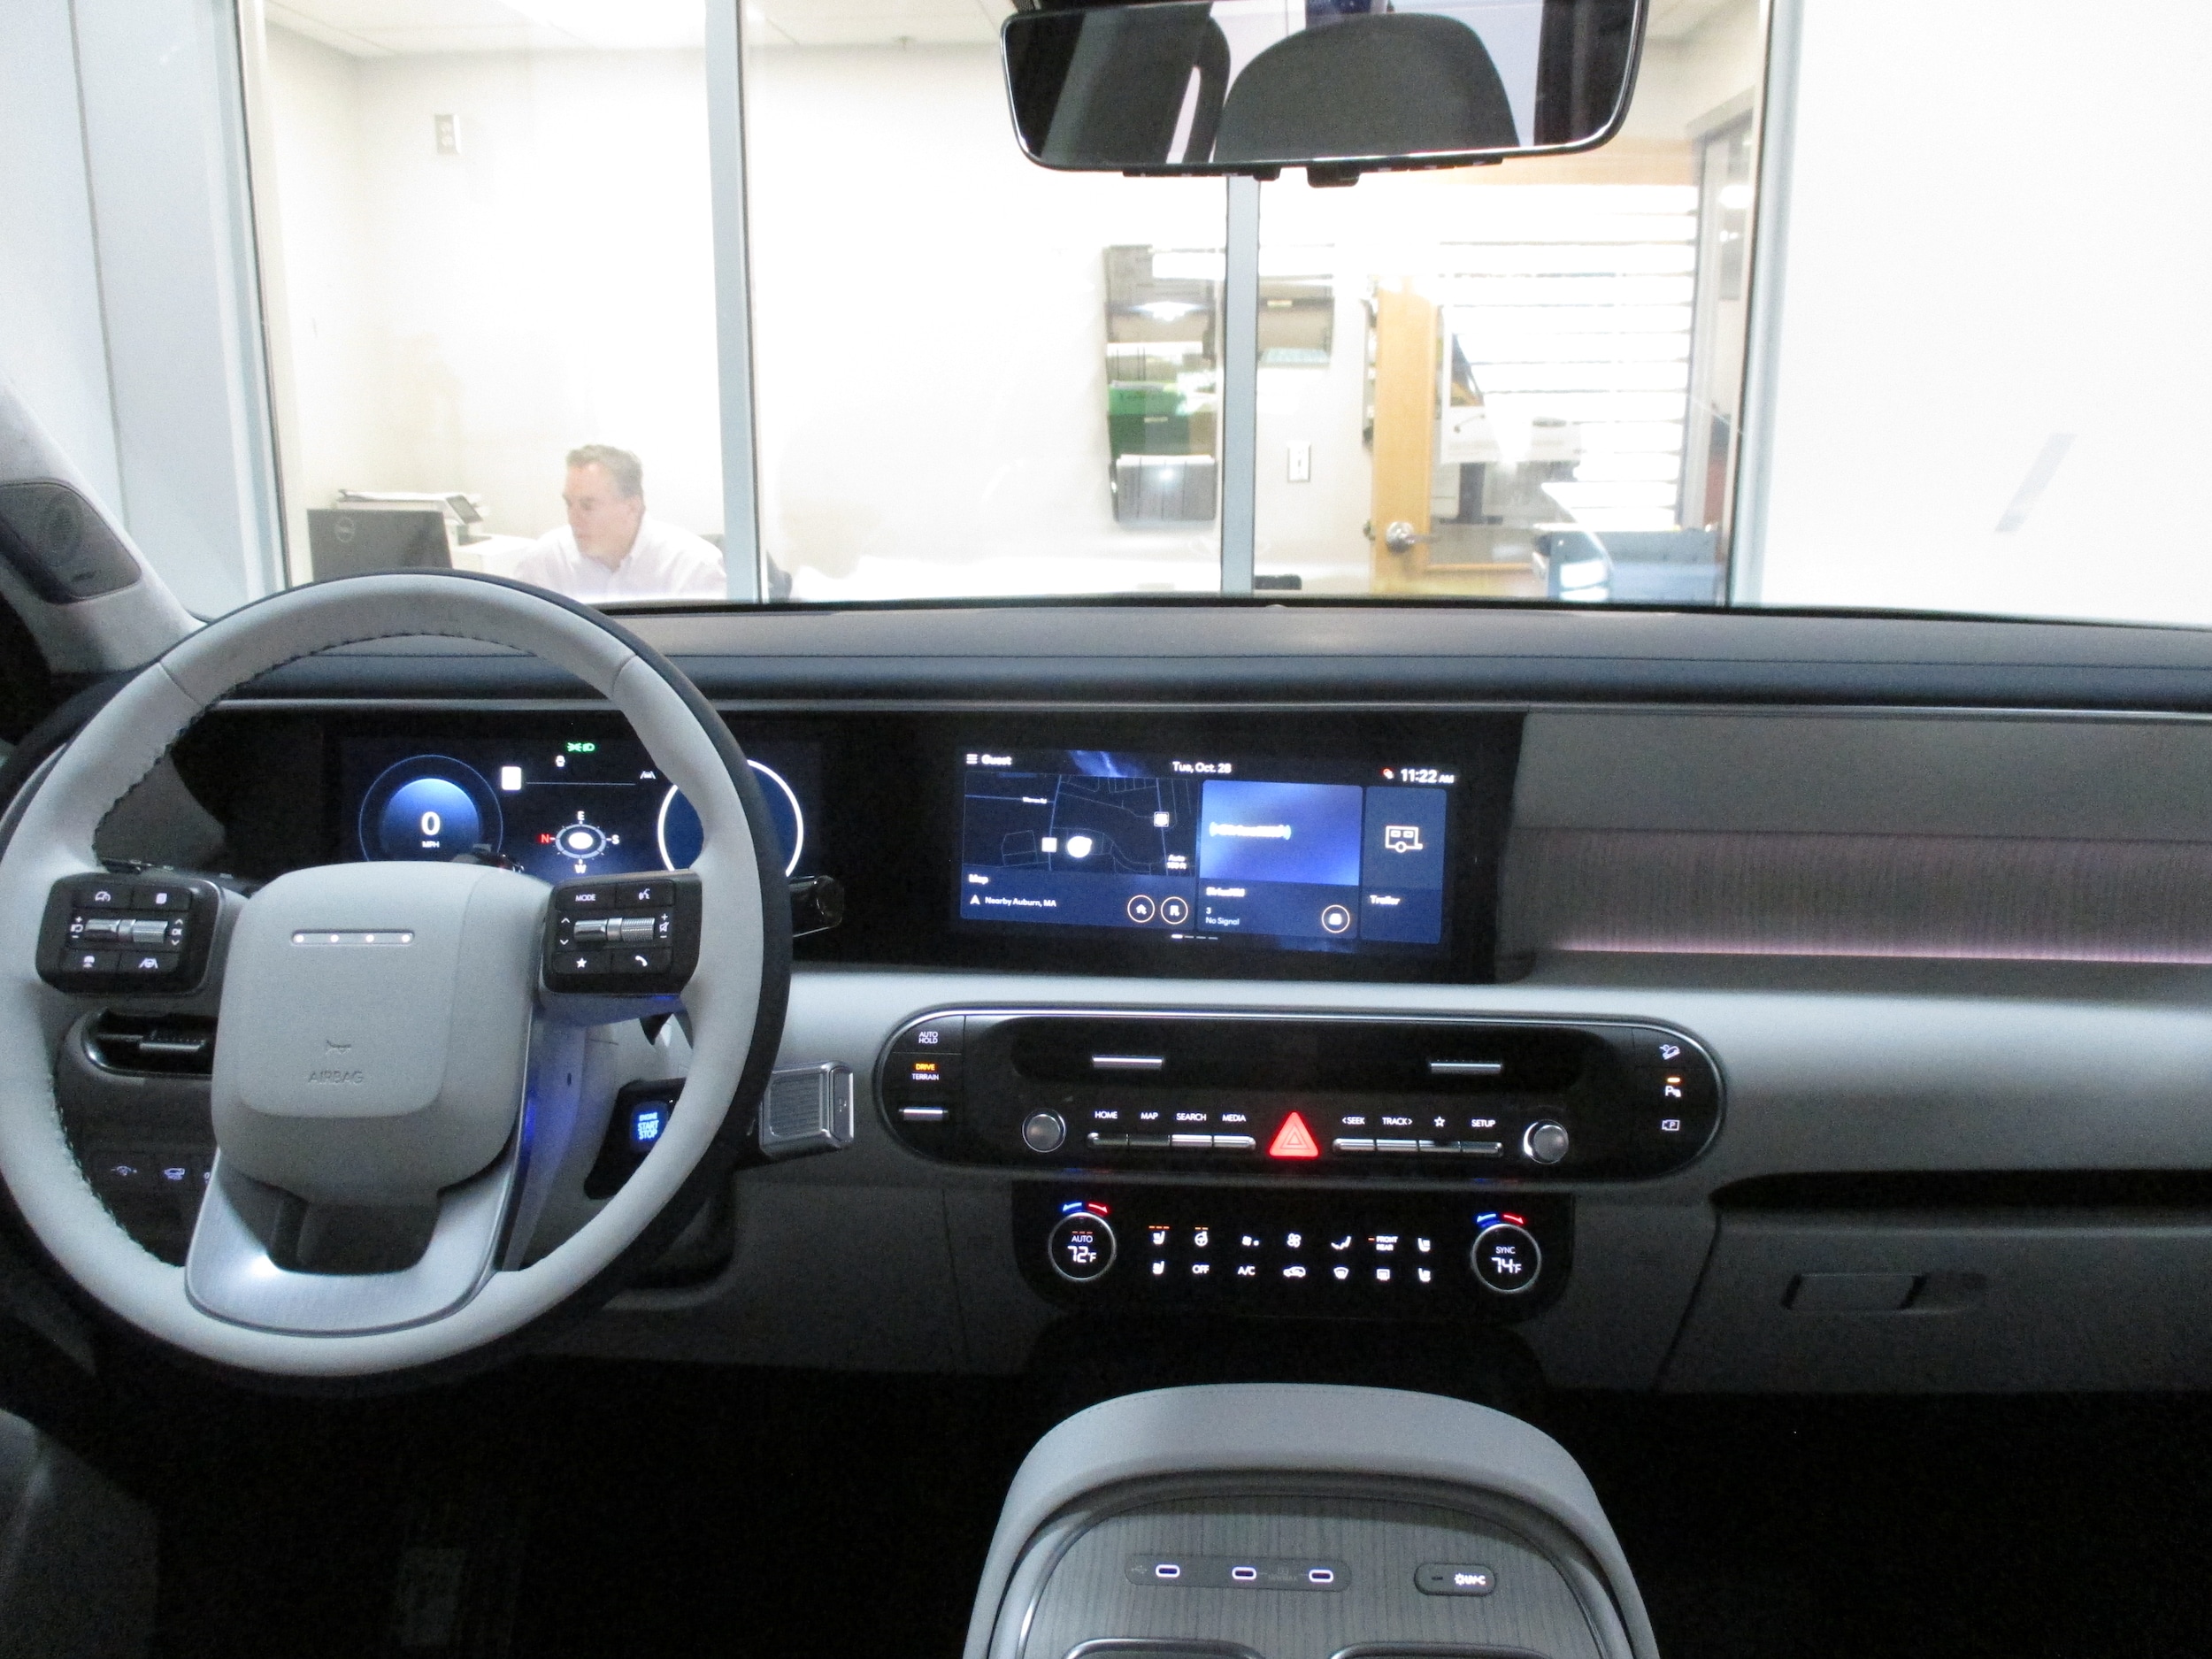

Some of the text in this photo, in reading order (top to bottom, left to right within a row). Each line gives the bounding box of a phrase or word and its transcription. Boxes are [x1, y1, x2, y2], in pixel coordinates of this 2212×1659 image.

[981, 754, 1012, 765] Guest
[1172, 761, 1232, 773] Tue, Oct. 28
[1401, 768, 1455, 783] 11:22 AM
[577, 810, 585, 820] E
[421, 810, 441, 835] 0
[541, 834, 549, 843] N
[611, 834, 619, 845] S
[574, 864, 587, 874] W
[985, 896, 1056, 908] Nearby Auburn, MA
[1217, 918, 1240, 926] Signal
[915, 1063, 935, 1071] DRIVE
[308, 1070, 364, 1085] AIRBAG
[1094, 1110, 1118, 1119] HOME
[1141, 1111, 1159, 1120] MAP
[1176, 1112, 1207, 1122] SEARCH
[637, 1119, 660, 1132] START
[1471, 1118, 1496, 1127] SETUP
[637, 1129, 658, 1140] STOP
[1071, 1234, 1094, 1243] AUTO
[1495, 1246, 1516, 1255] SYNC
[1192, 1263, 1210, 1274] OFF
[1237, 1265, 1256, 1276] A/C
